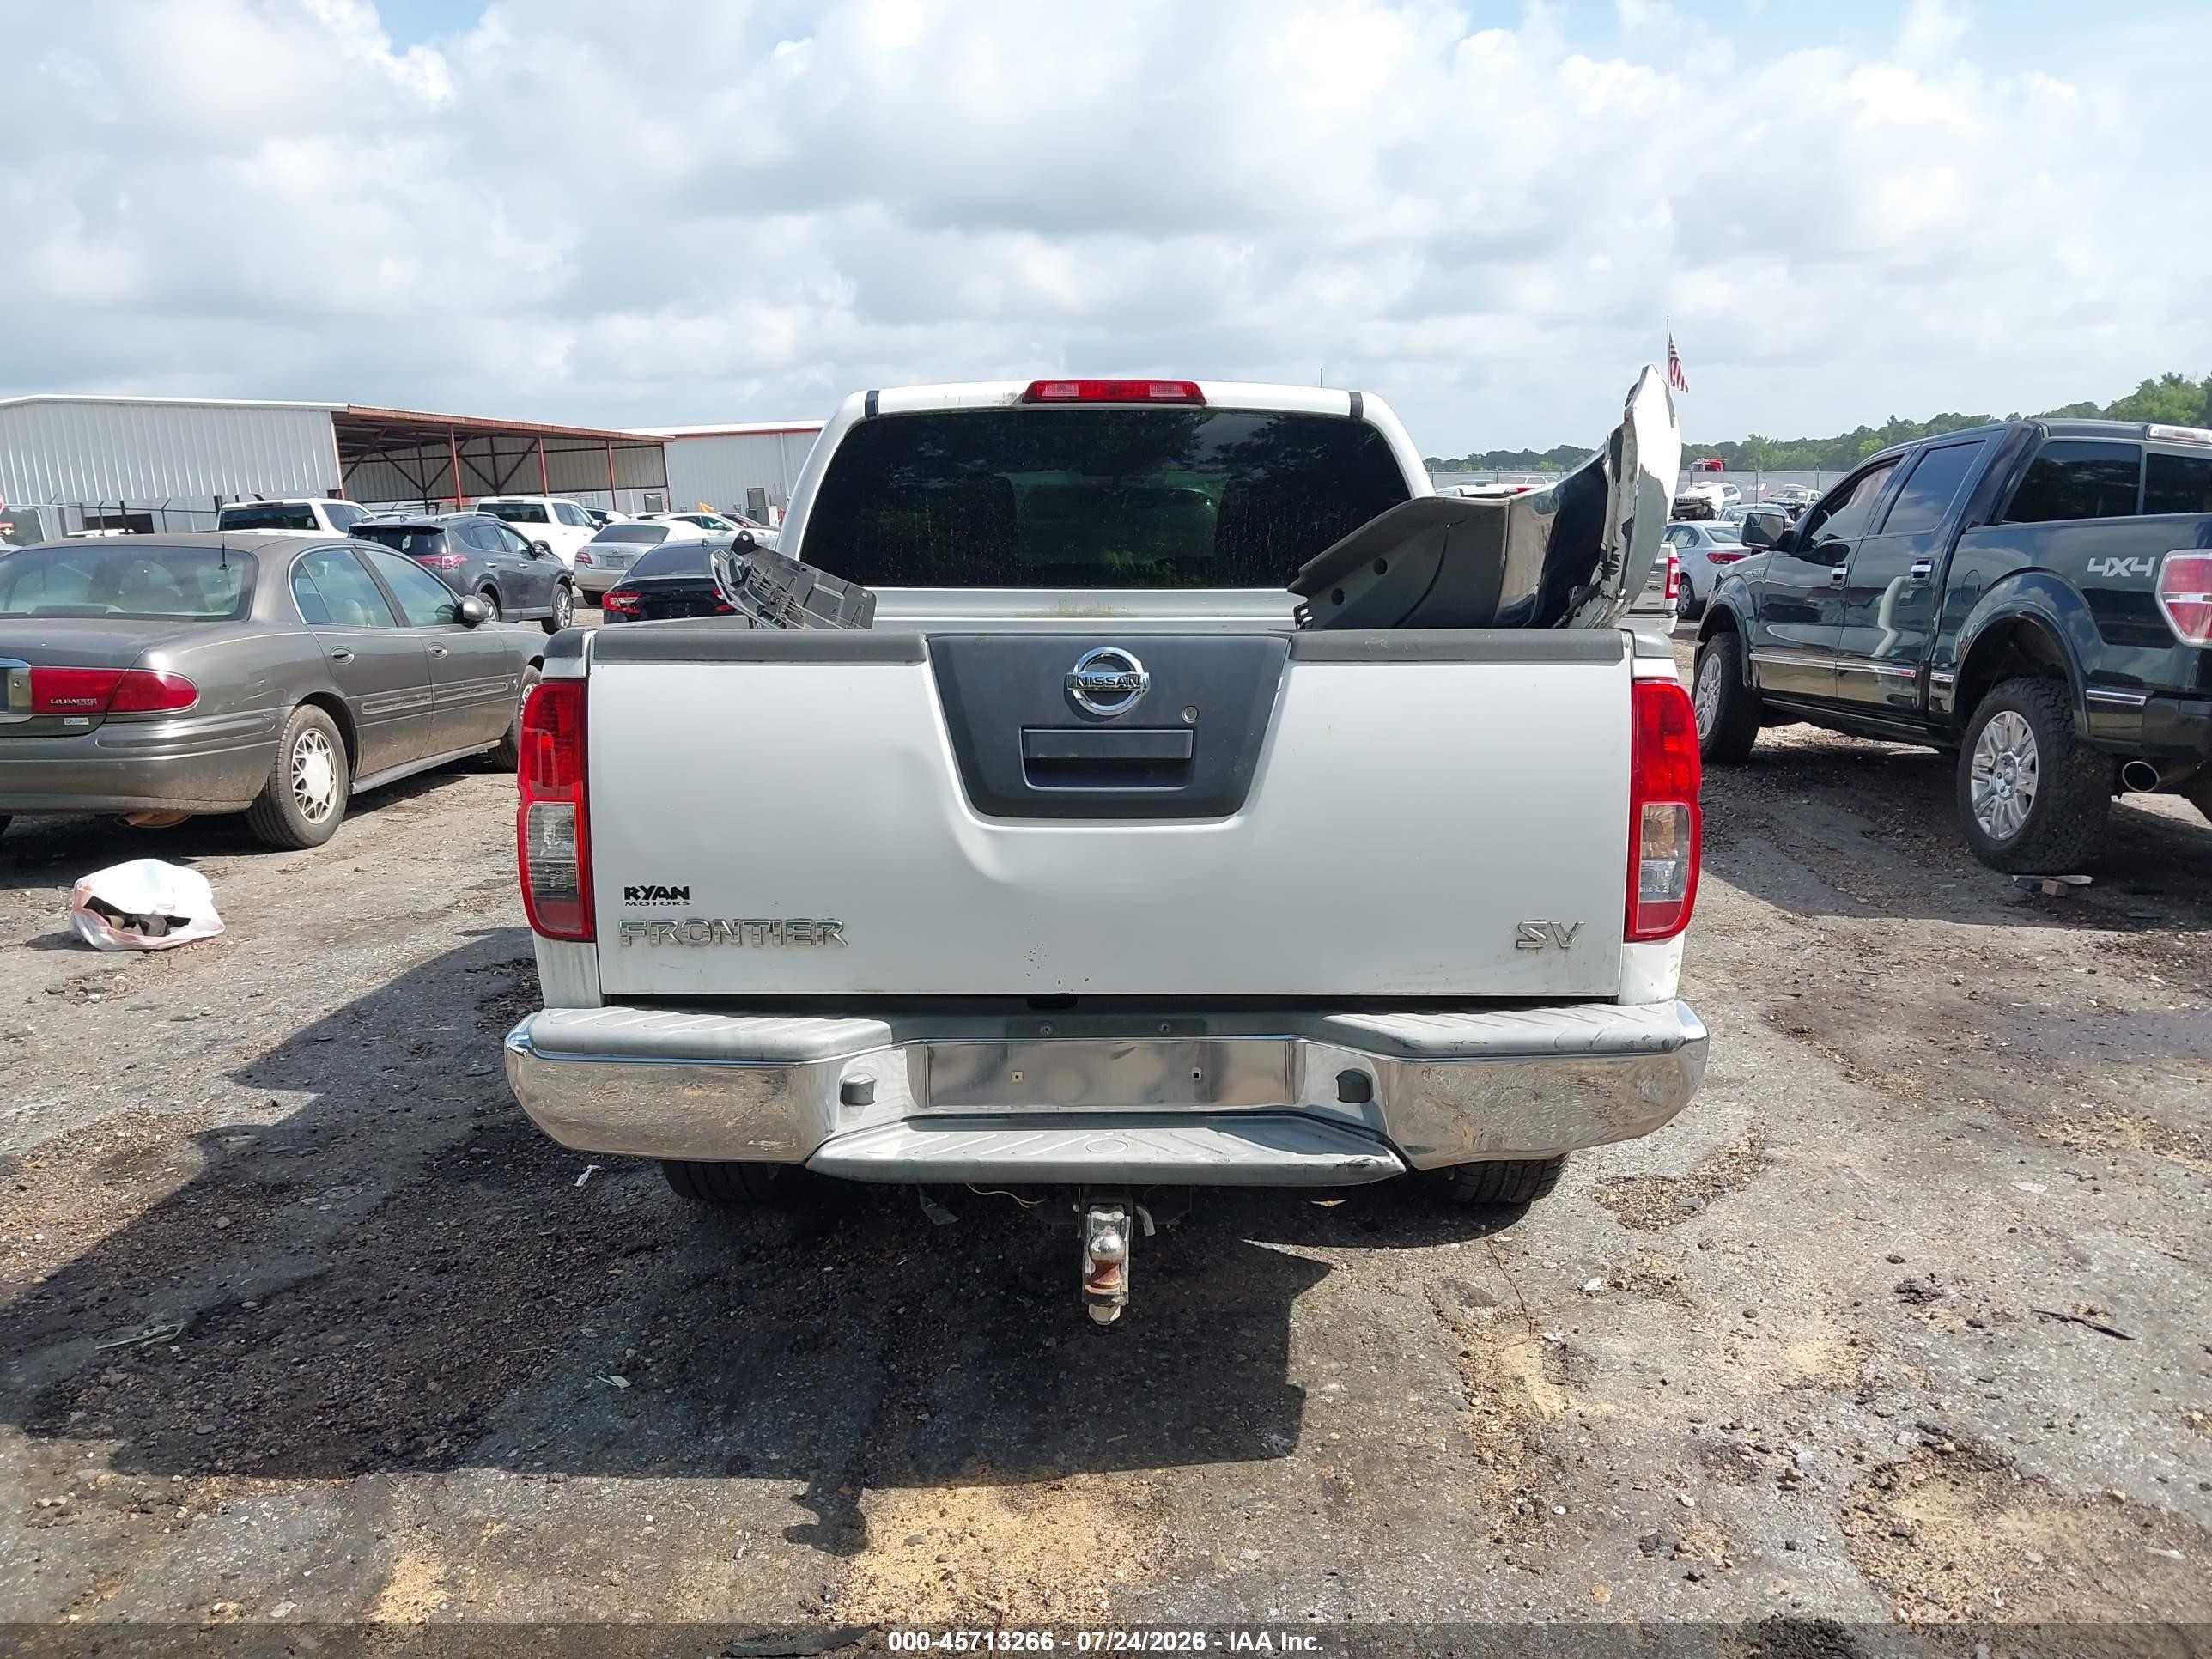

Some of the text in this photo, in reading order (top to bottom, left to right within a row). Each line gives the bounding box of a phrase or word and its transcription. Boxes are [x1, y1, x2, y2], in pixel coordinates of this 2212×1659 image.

[2087, 556, 2156, 577] 4X4
[1076, 676, 1141, 688] NISSAN
[624, 885, 690, 901] RYAN
[619, 918, 848, 947] FRONTIER
[1516, 920, 1586, 949] SV
